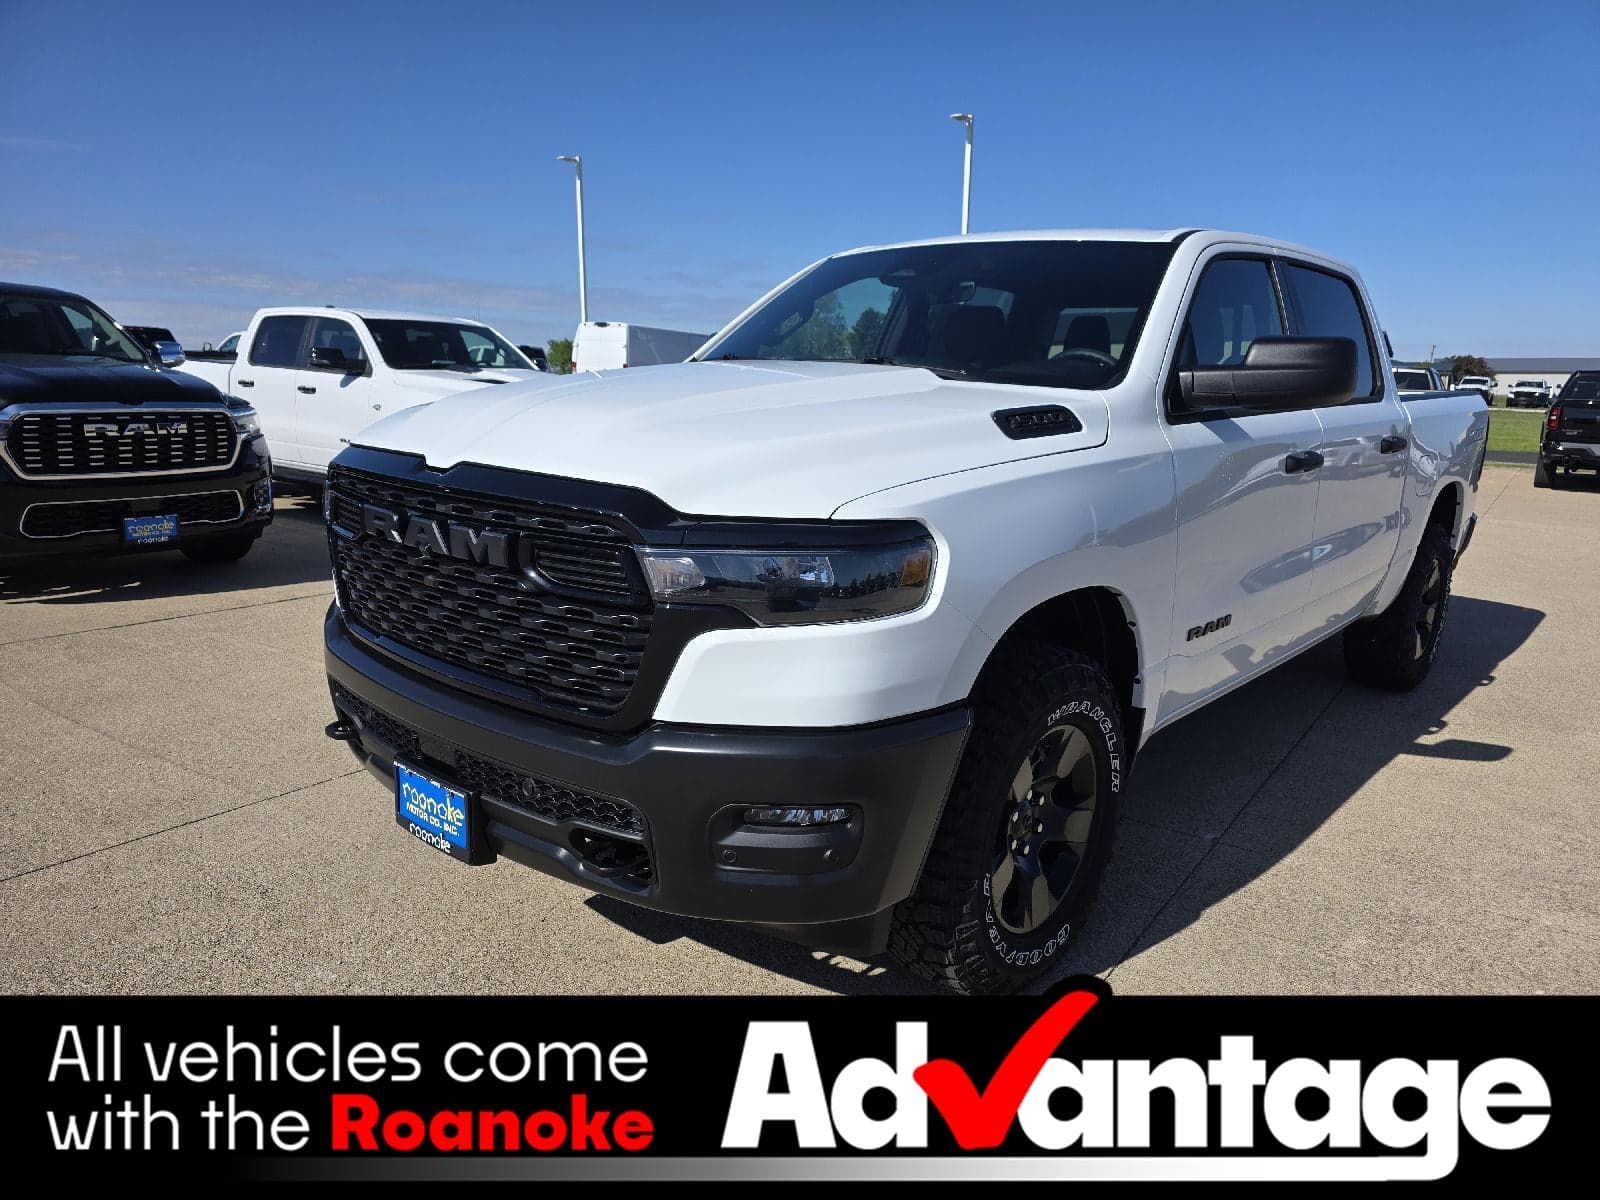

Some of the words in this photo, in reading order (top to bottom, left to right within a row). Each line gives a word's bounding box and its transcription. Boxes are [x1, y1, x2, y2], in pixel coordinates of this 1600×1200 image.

[83, 423, 188, 437] RAM
[360, 503, 510, 569] RAM
[1186, 613, 1232, 642] RAM
[1047, 700, 1120, 793] WRANGLER
[402, 782, 465, 827] roanoke
[406, 801, 429, 822] MOTOR
[409, 822, 451, 854] roanoke
[983, 872, 1071, 966] GOODYEAR
